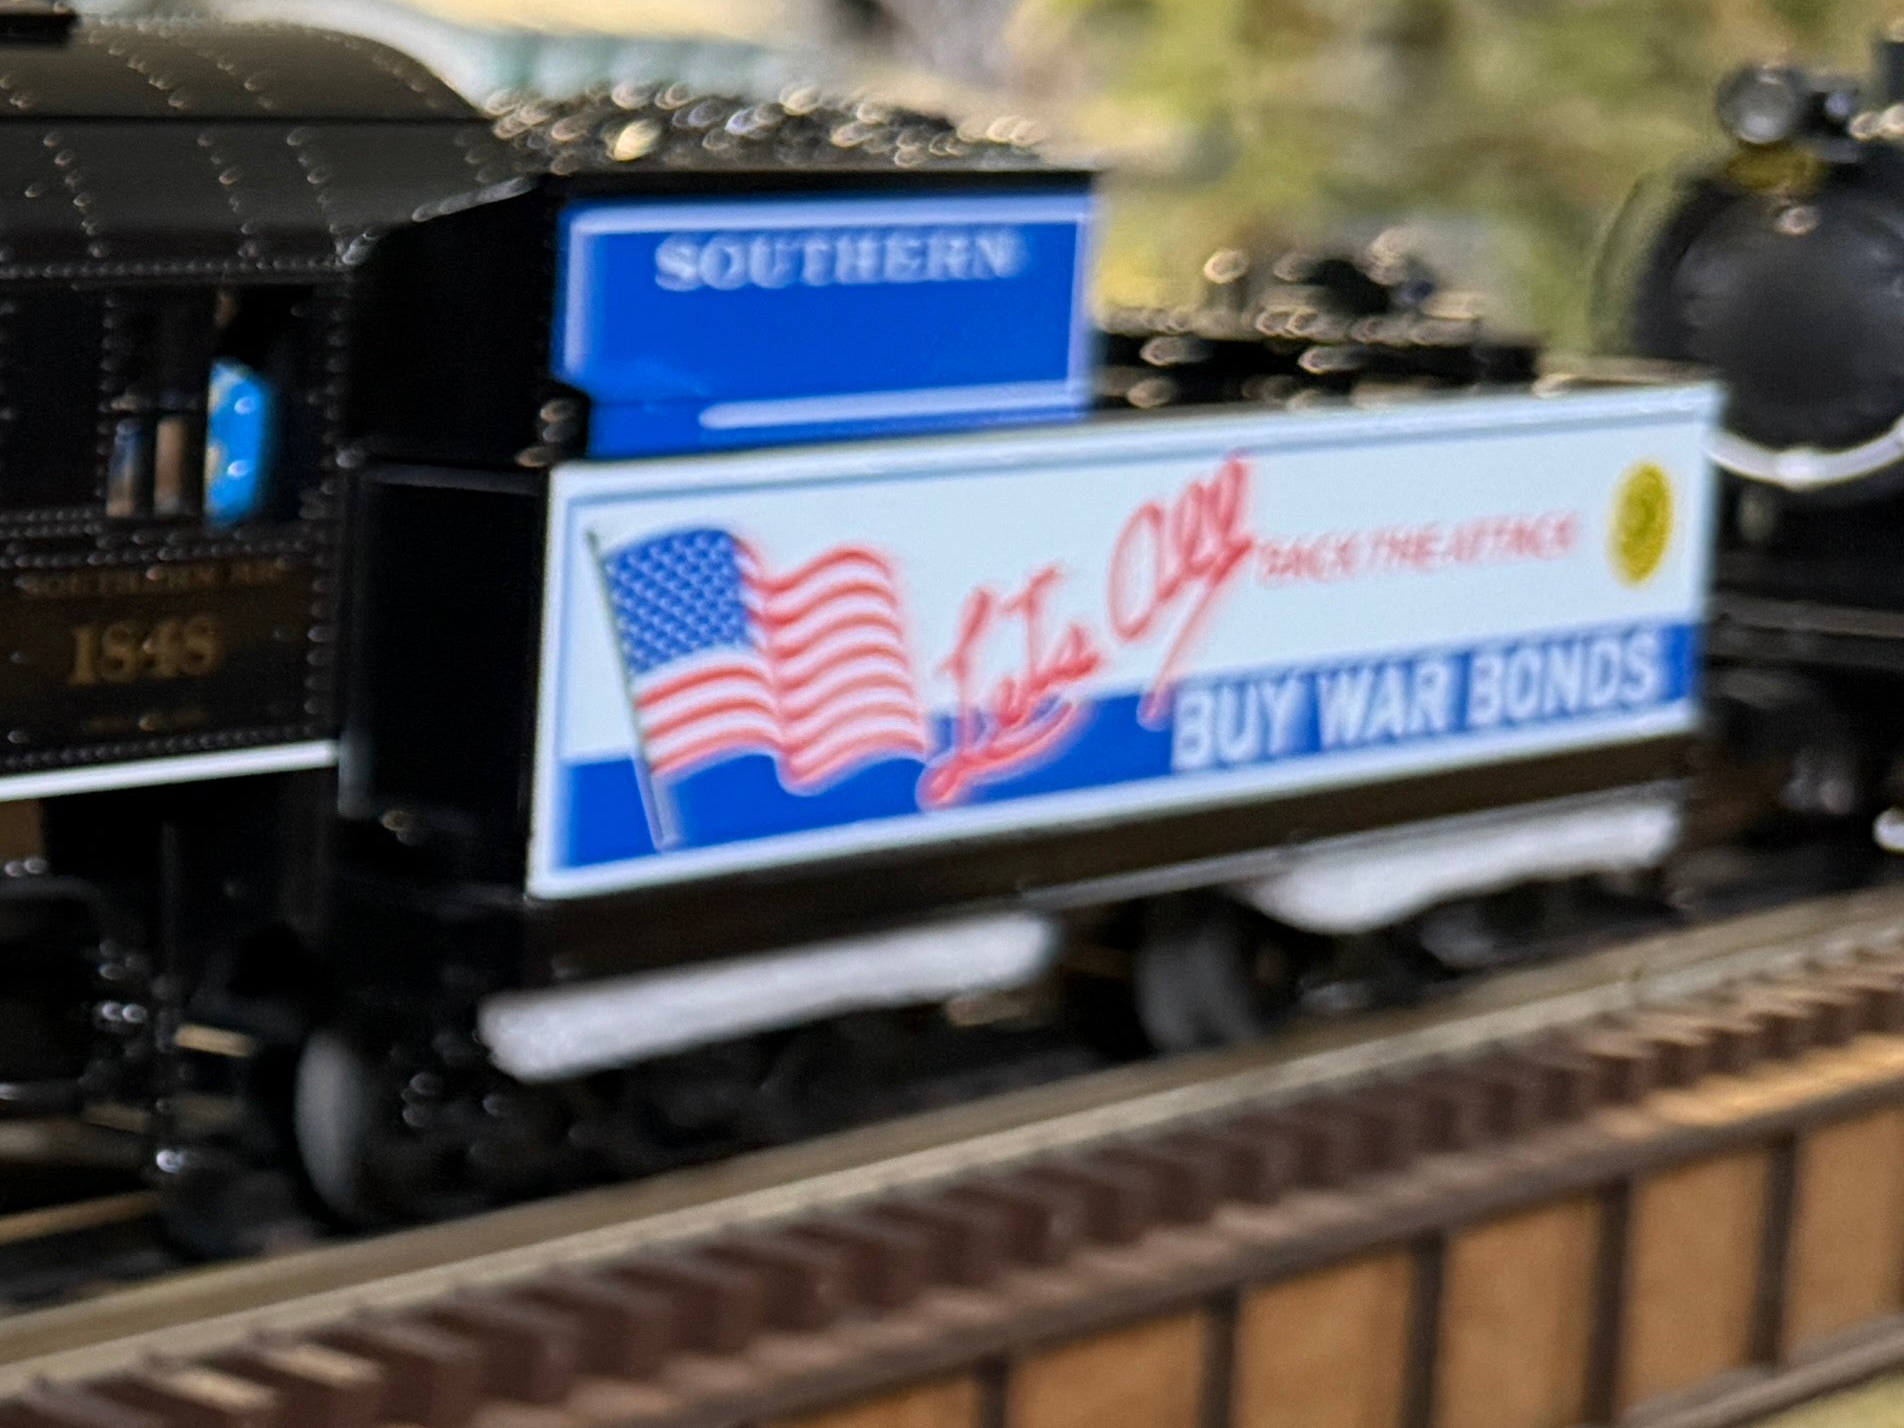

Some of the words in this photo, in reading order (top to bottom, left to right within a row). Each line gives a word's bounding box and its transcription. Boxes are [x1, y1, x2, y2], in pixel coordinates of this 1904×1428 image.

[655, 229, 1028, 292] SOUTHERN
[70, 615, 225, 686] 1848
[1172, 674, 1306, 771] BUY
[1318, 658, 1454, 749] WAR
[1465, 628, 1664, 730] BONDS
